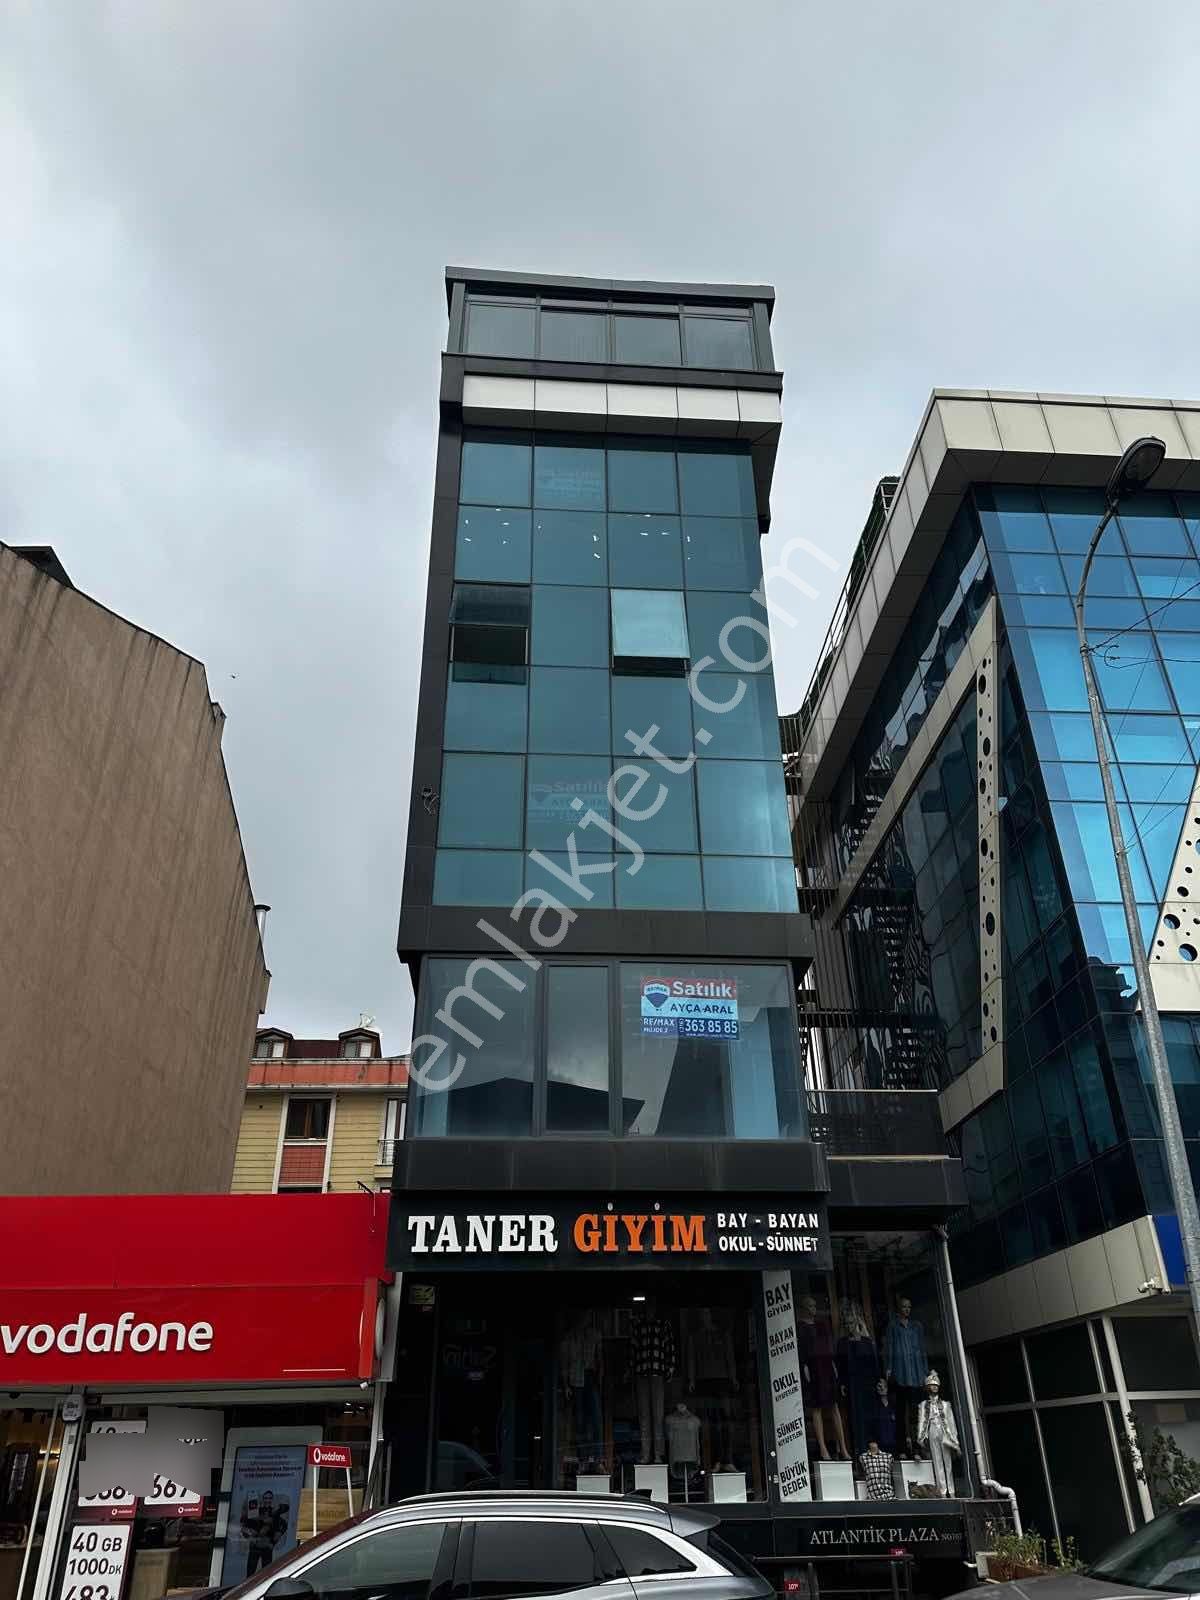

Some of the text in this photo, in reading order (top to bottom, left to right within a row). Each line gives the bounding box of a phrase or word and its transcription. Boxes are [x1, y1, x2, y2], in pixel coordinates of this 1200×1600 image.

[672, 980, 732, 998] Satılık
[643, 1018, 675, 1027] RE/MAX
[685, 1019, 704, 1032] 363
[707, 1020, 721, 1033] 85
[724, 1021, 738, 1034] 85
[407, 1202, 708, 1253] TANER GİYİM
[717, 1212, 748, 1228] BAY
[768, 1213, 819, 1228] BAYAN
[765, 1283, 790, 1307] BAY
[767, 1303, 792, 1318] GİYİM
[1, 1312, 213, 1354] vodafone
[769, 1326, 794, 1348] BAYAN
[770, 1341, 795, 1358] GİYİM
[773, 1371, 799, 1393] OKUL
[776, 1416, 803, 1438] SÜNNET
[321, 1451, 346, 1462] vodafone
[780, 1461, 807, 1483] BÜYÜK
[782, 1475, 809, 1497] BEDEN
[73, 1532, 122, 1552] 40 GB
[809, 1525, 887, 1545] ATLANTİK
[888, 1527, 940, 1543] PLAZA
